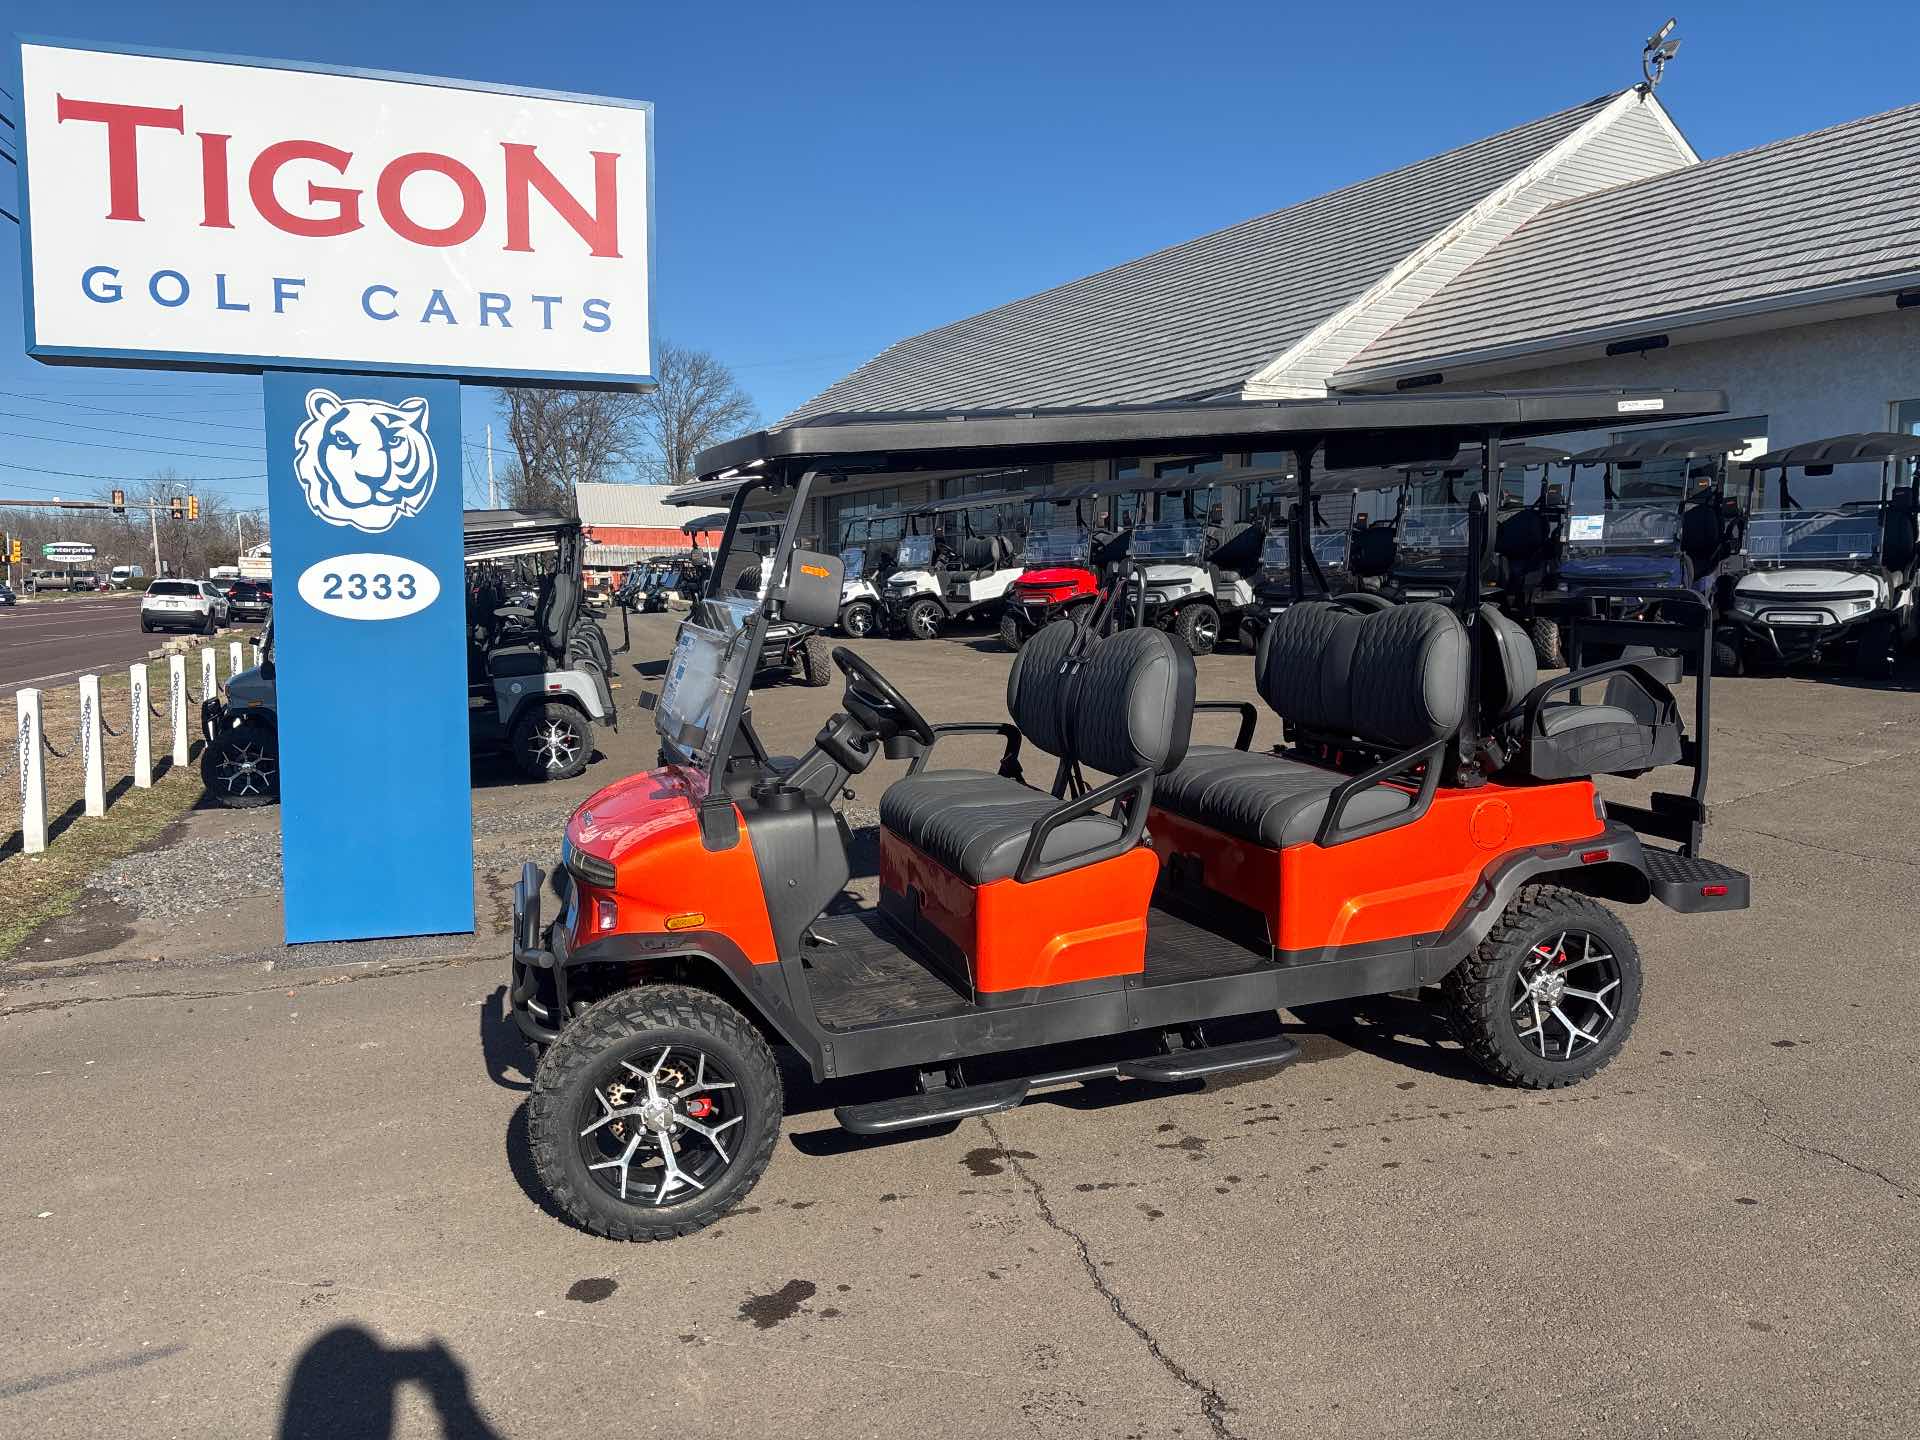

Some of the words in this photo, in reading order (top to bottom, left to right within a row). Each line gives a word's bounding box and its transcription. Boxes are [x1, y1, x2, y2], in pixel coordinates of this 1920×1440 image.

[57, 94, 622, 260] TIGON
[82, 266, 306, 314] GOLF
[362, 284, 612, 334] CARTS
[46, 546, 96, 554] enterprise
[323, 573, 417, 600] 2333
